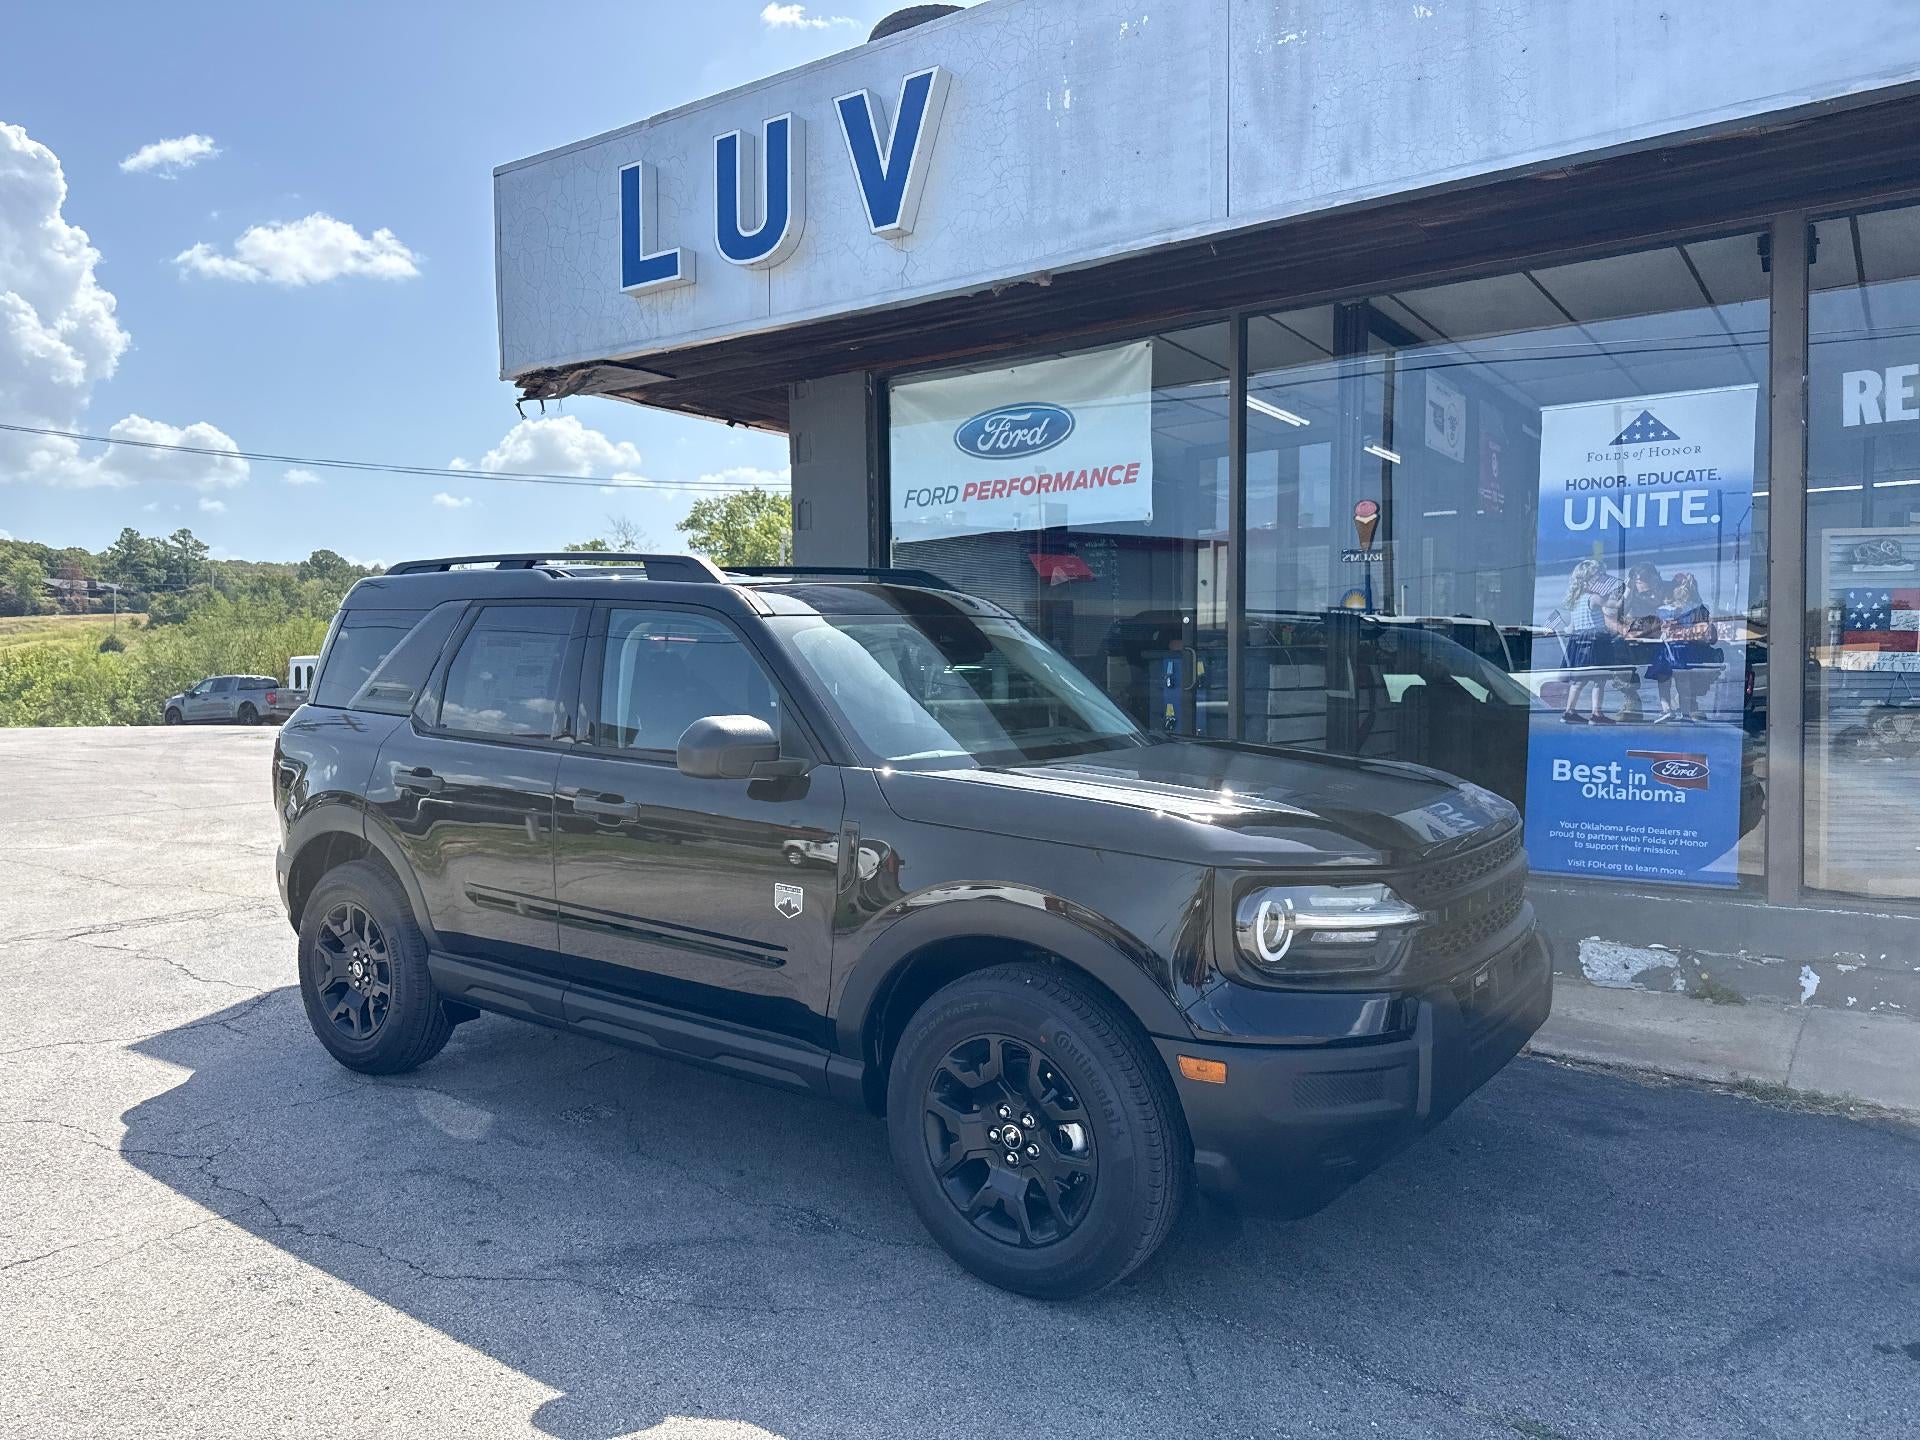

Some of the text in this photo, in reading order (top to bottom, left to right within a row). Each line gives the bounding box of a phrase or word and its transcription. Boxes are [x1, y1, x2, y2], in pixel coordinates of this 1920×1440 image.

[618, 64, 949, 295] LUV
[1842, 364, 1920, 427] RE
[977, 412, 1049, 451] Ford
[1632, 448, 1644, 461] of
[904, 462, 1141, 509] FORD PERFORMANCE
[1565, 468, 1722, 491] HONOR. EDUCATE.
[1563, 489, 1721, 531] UNITE.
[1552, 759, 1647, 785] Best in
[1662, 762, 1698, 777] Ford
[1582, 783, 1686, 803] Oklahoma
[1560, 820, 1579, 829] Your
[1580, 822, 1623, 832] Oklahoma
[1625, 825, 1645, 833] Ford
[1648, 826, 1681, 836] Dealers
[1549, 830, 1574, 838] proud
[1588, 833, 1619, 841] partner
[1621, 834, 1640, 843] with
[1642, 835, 1666, 845] Folds
[1668, 838, 1678, 846] of
[1680, 838, 1709, 848] Honor
[1574, 841, 1680, 855] to support their mission.
[1567, 859, 1686, 876] Visit FOH.org to learn more.
